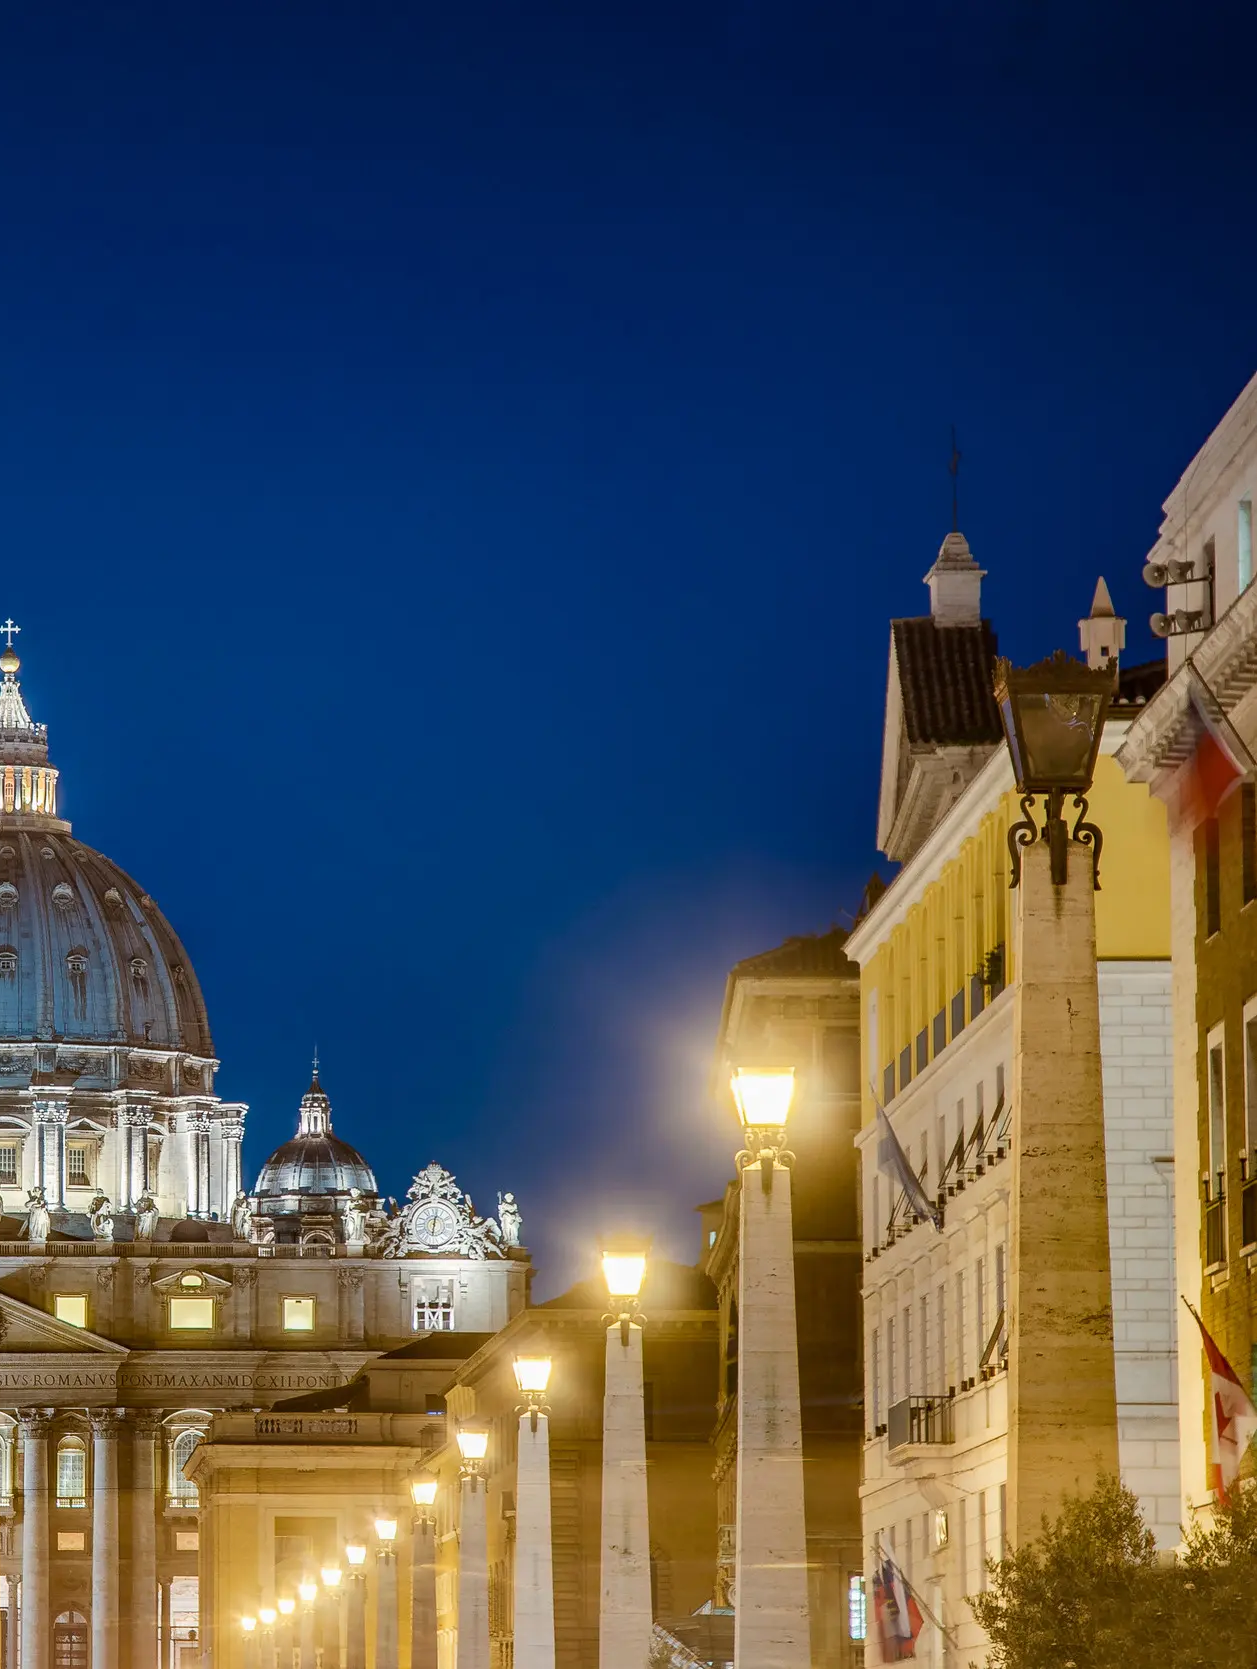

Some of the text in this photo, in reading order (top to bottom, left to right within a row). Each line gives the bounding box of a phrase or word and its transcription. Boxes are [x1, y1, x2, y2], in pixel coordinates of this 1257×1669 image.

[33, 1374, 116, 1387] ROMANVS
[121, 1374, 163, 1387] PONT
[164, 1374, 199, 1387] MAX
[200, 1375, 224, 1387] AN
[226, 1375, 293, 1388] MDCXII
[297, 1375, 340, 1388] PONT
